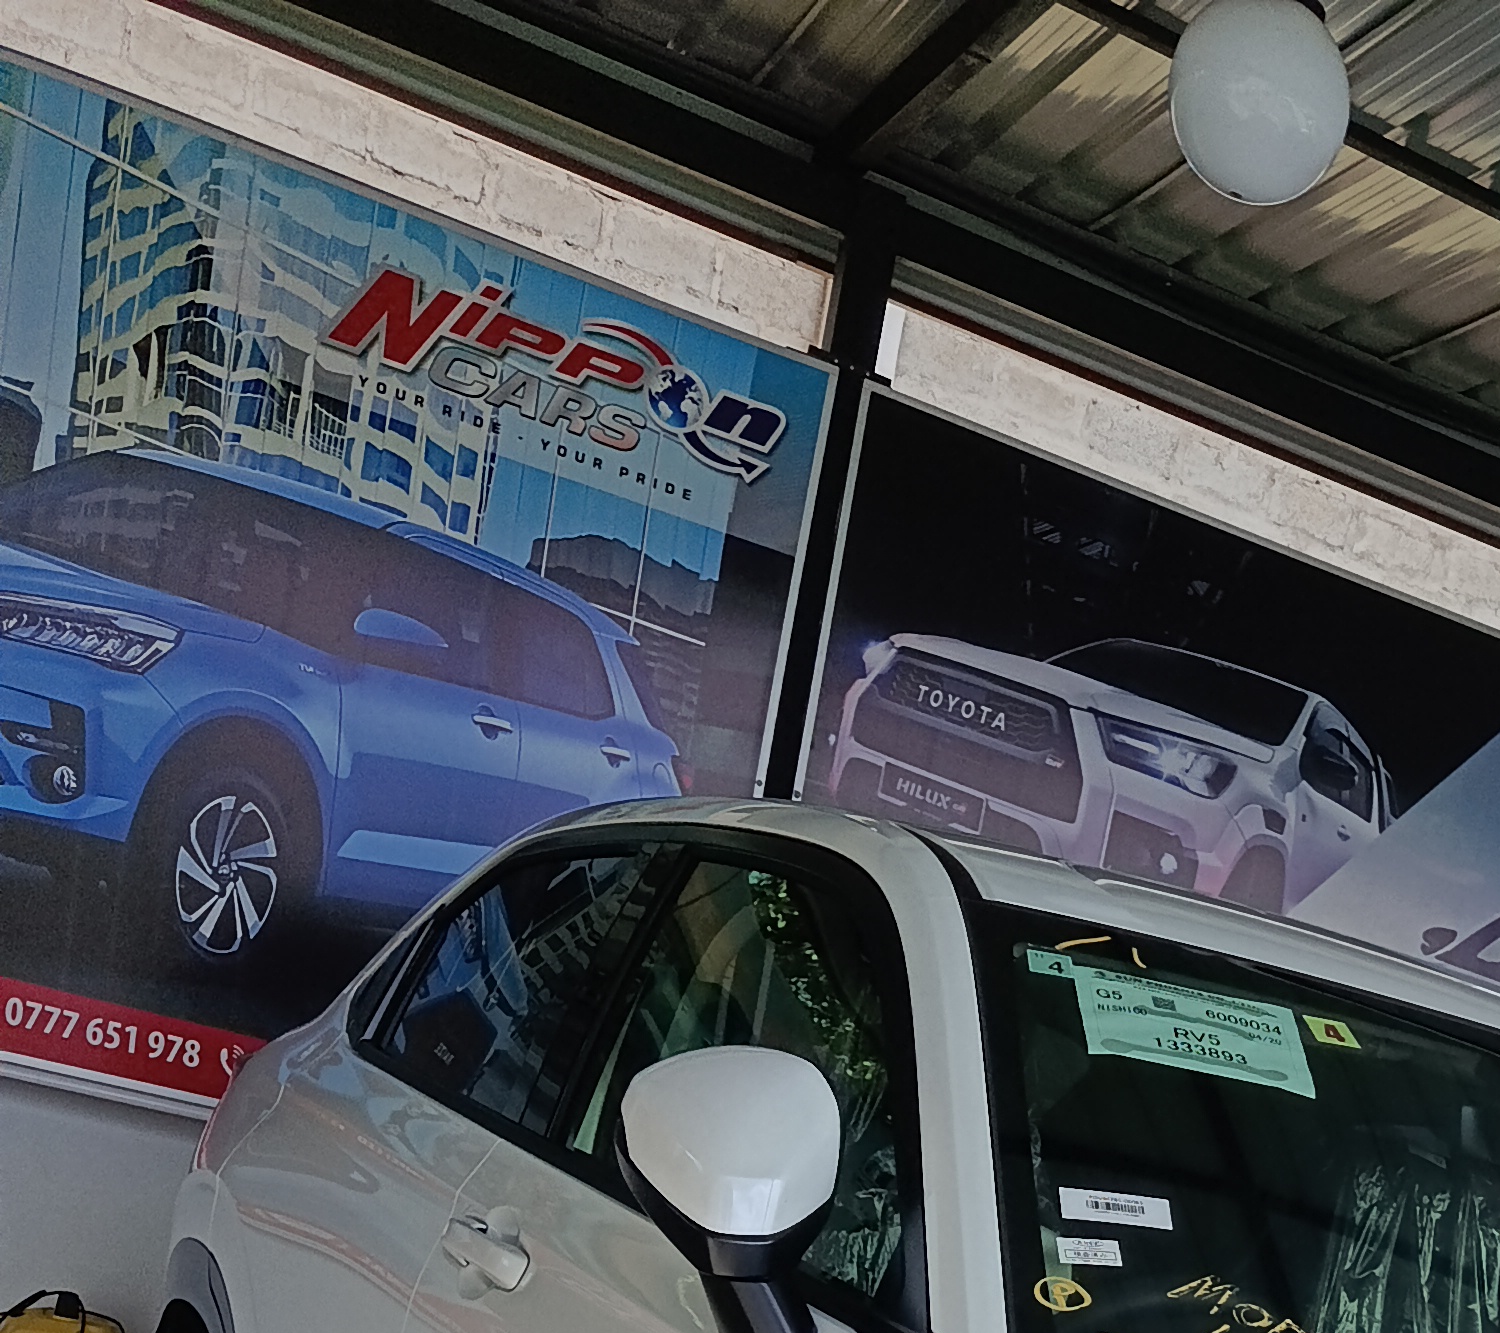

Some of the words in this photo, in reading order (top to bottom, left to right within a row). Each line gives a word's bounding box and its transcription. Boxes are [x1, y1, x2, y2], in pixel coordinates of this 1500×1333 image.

[428, 345, 648, 453] CARS
[358, 375, 426, 409] YOUR
[442, 404, 502, 436] RIDE
[540, 438, 603, 470] YOUR
[619, 466, 693, 501] PRIDE
[917, 684, 1006, 731] TOYOTA
[896, 777, 953, 810] HILUX
[1048, 961, 1064, 974] 4
[4, 997, 80, 1039] 0777
[85, 1018, 138, 1054] 651
[148, 1031, 201, 1068] 978
[1173, 1026, 1221, 1046] RV5
[1205, 1009, 1282, 1036] 6009034
[1323, 1023, 1346, 1043] 4
[1153, 1036, 1248, 1065] 1333893
